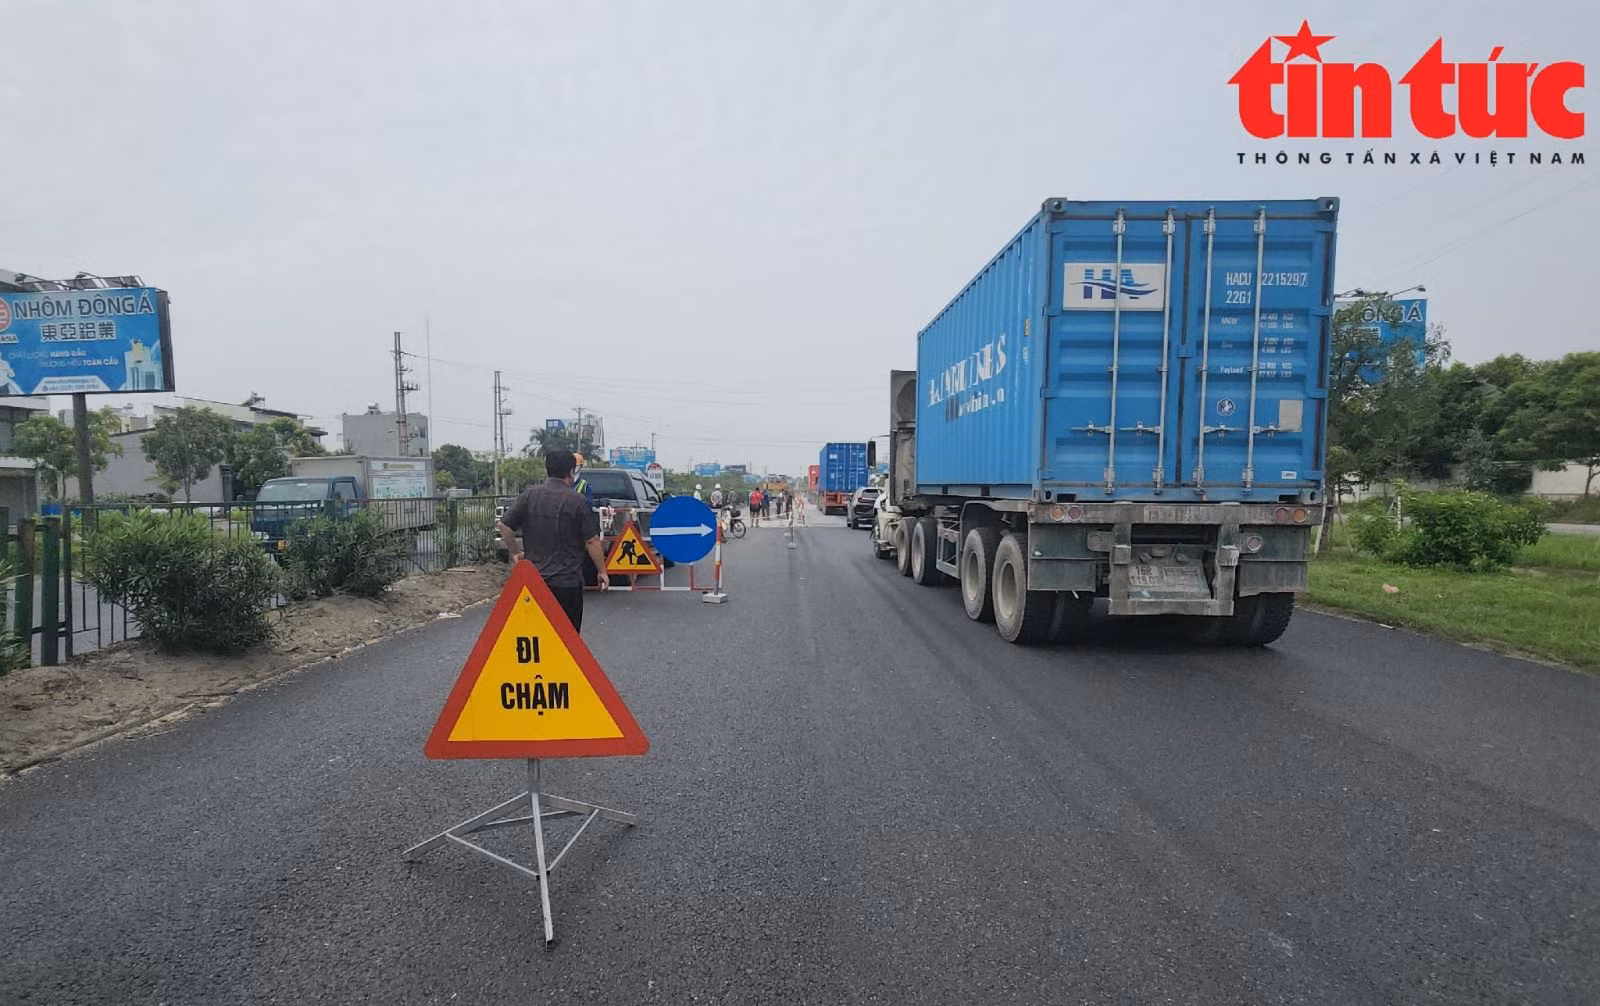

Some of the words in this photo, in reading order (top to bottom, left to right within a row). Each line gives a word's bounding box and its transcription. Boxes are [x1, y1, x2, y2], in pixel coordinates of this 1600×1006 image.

[1226, 272, 1252, 286] HACU
[1261, 272, 1308, 287] 2215297
[14, 295, 73, 319] NHÔM
[77, 293, 135, 316] ĐÔNG
[138, 290, 153, 314] Á
[1226, 291, 1251, 304] 22G1
[1405, 300, 1423, 322] Á
[1220, 367, 1244, 375] Payload
[516, 636, 540, 663] ĐI
[500, 674, 569, 716] CHẬM
